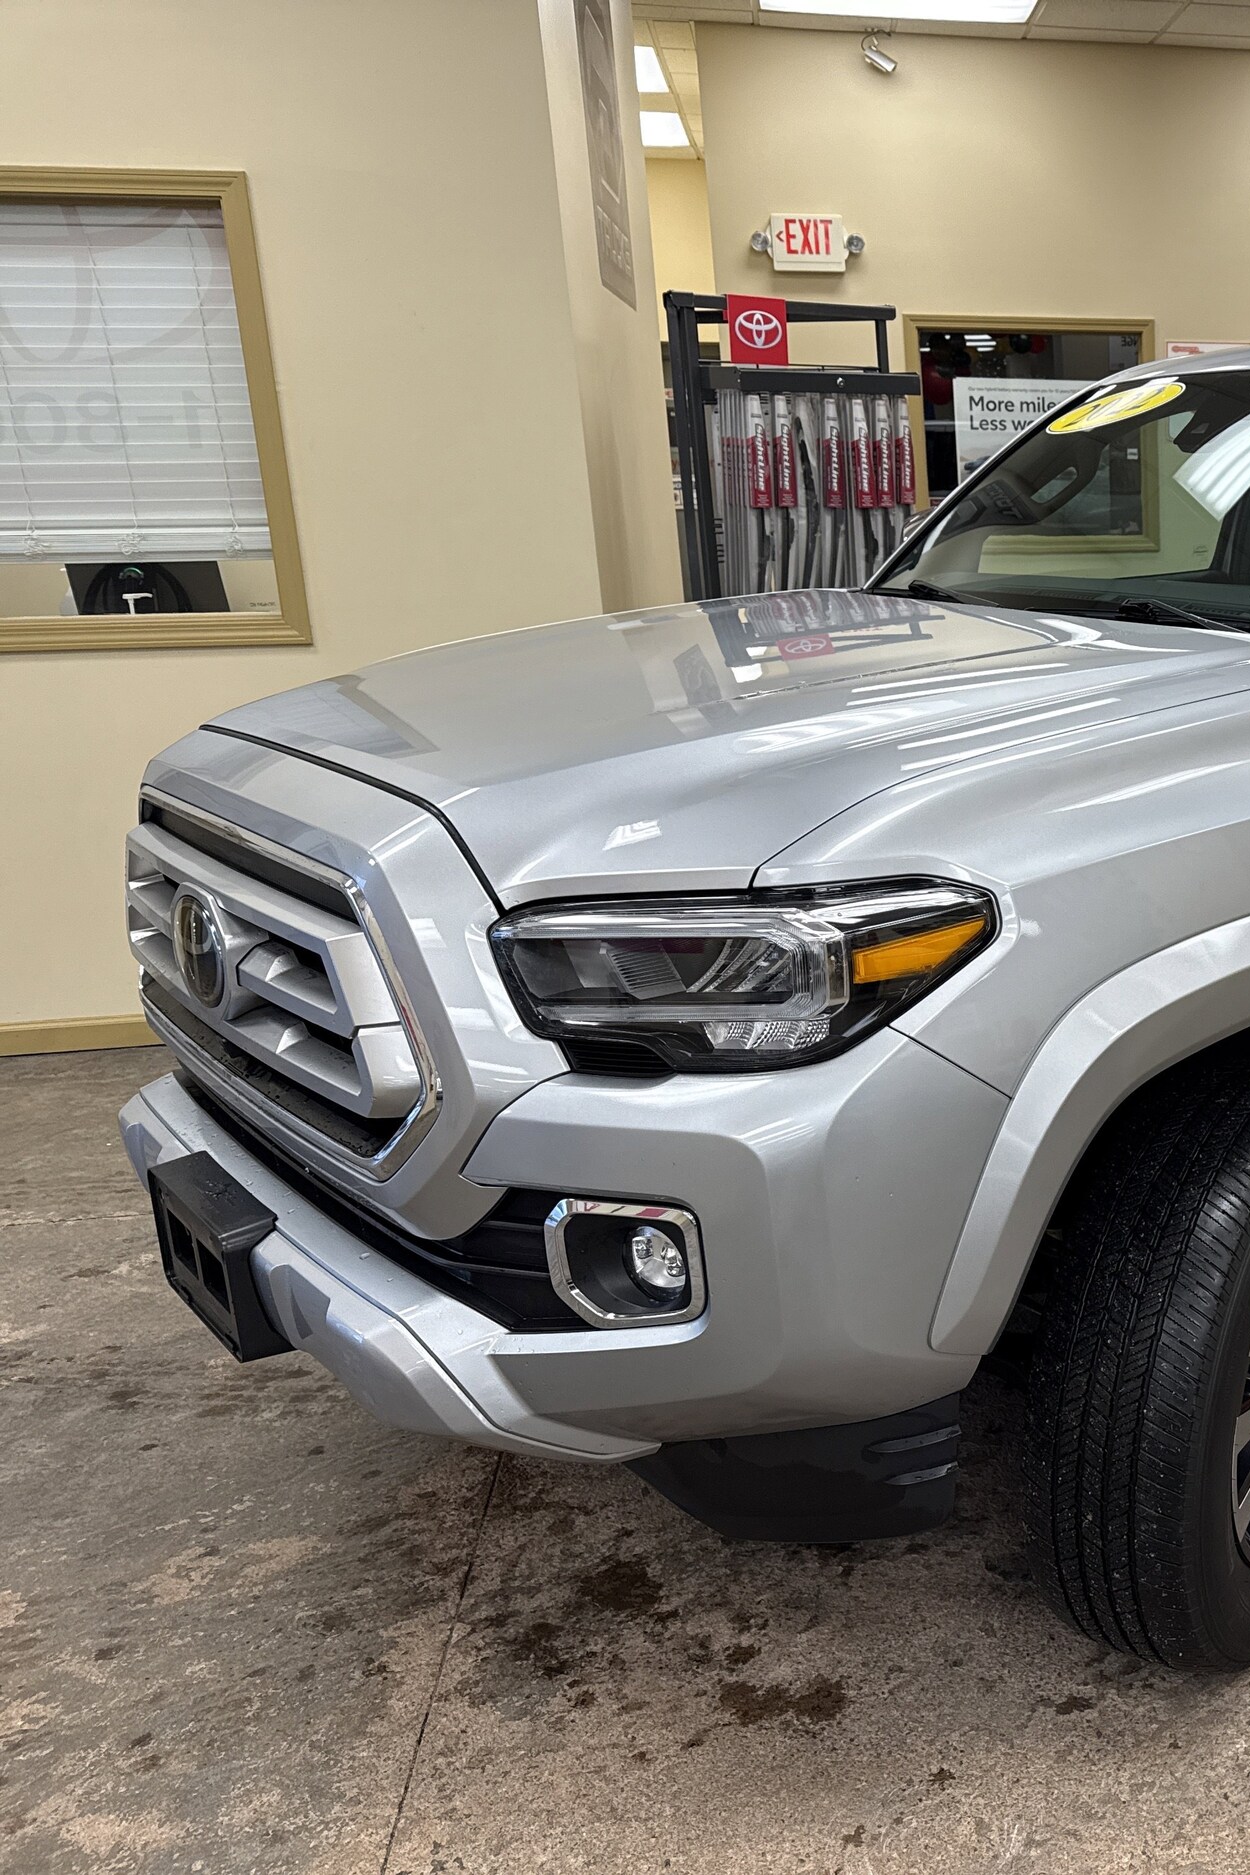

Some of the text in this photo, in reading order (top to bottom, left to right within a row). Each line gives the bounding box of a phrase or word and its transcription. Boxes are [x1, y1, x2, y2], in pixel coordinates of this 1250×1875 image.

[784, 219, 832, 255] EXIT
[969, 396, 1014, 412] More
[970, 415, 1007, 430] Less
